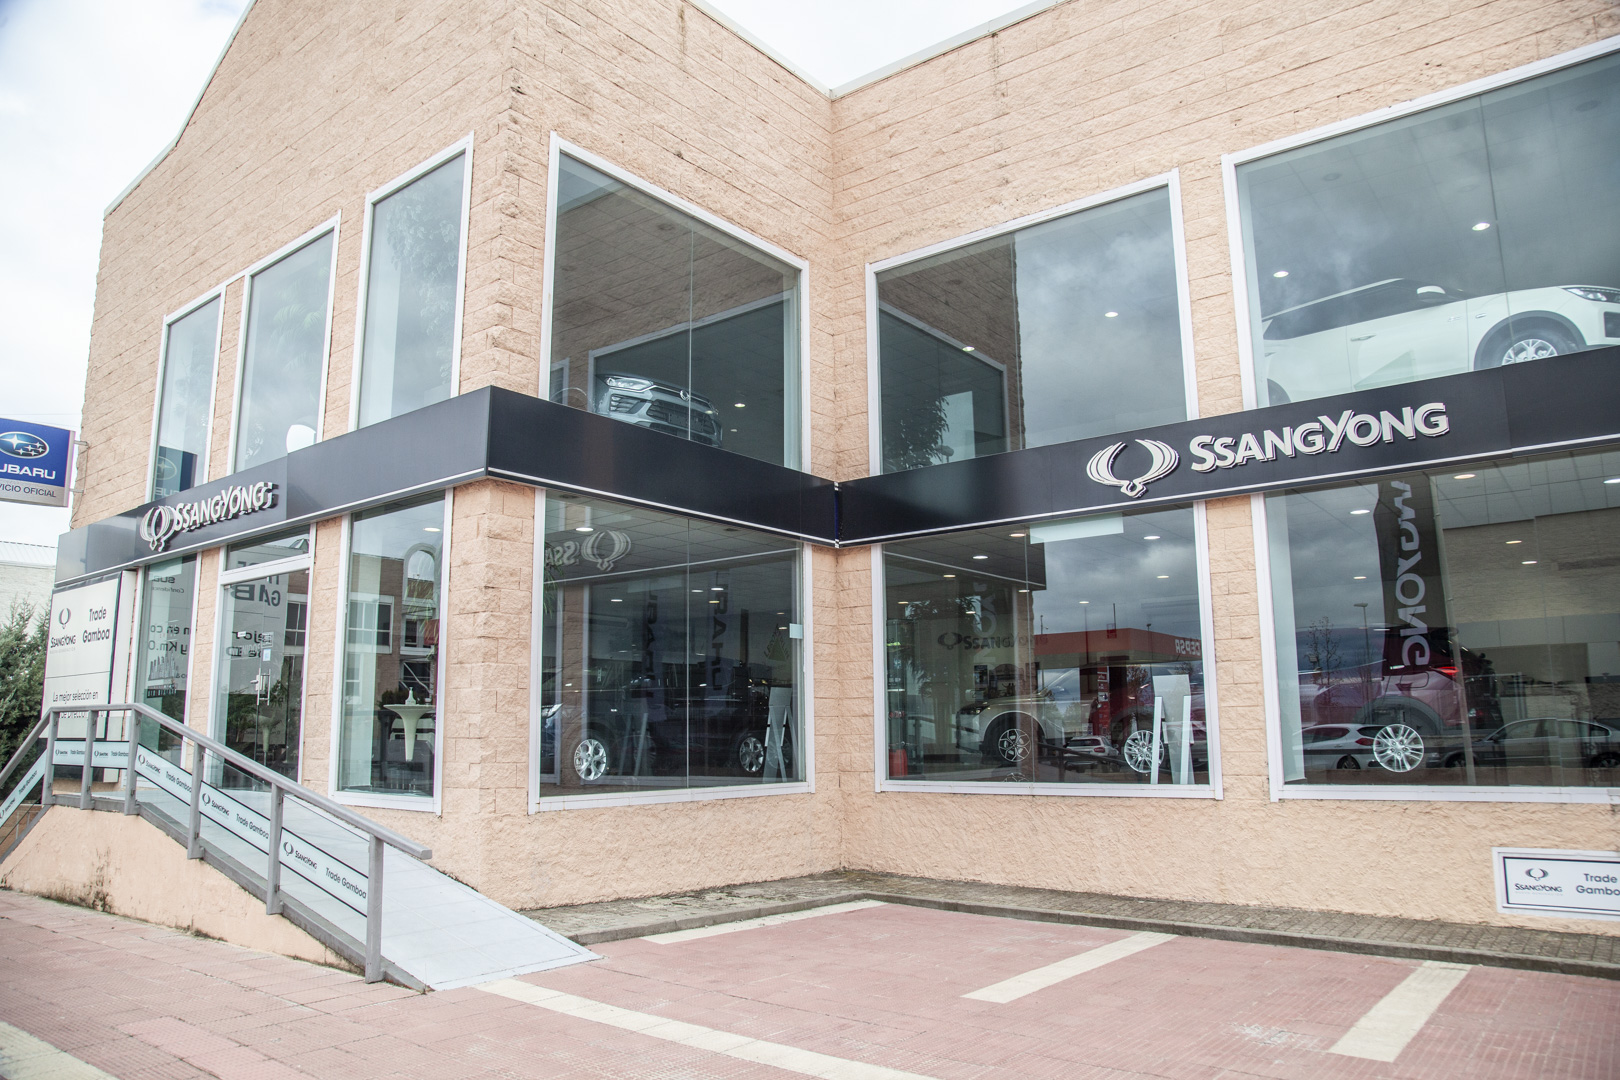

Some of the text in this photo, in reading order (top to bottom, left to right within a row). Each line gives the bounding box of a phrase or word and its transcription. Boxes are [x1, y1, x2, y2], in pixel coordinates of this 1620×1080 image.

[1189, 402, 1449, 473] SSANGYONG
[23, 486, 57, 498] OFICIAL
[174, 481, 273, 533] SSANGYONG
[89, 606, 107, 622] Trade
[82, 627, 111, 644] Gamboa
[325, 867, 367, 899] Trade Gamboa
[1583, 873, 1618, 883] Trade
[1514, 883, 1563, 892] SSANGYONG
